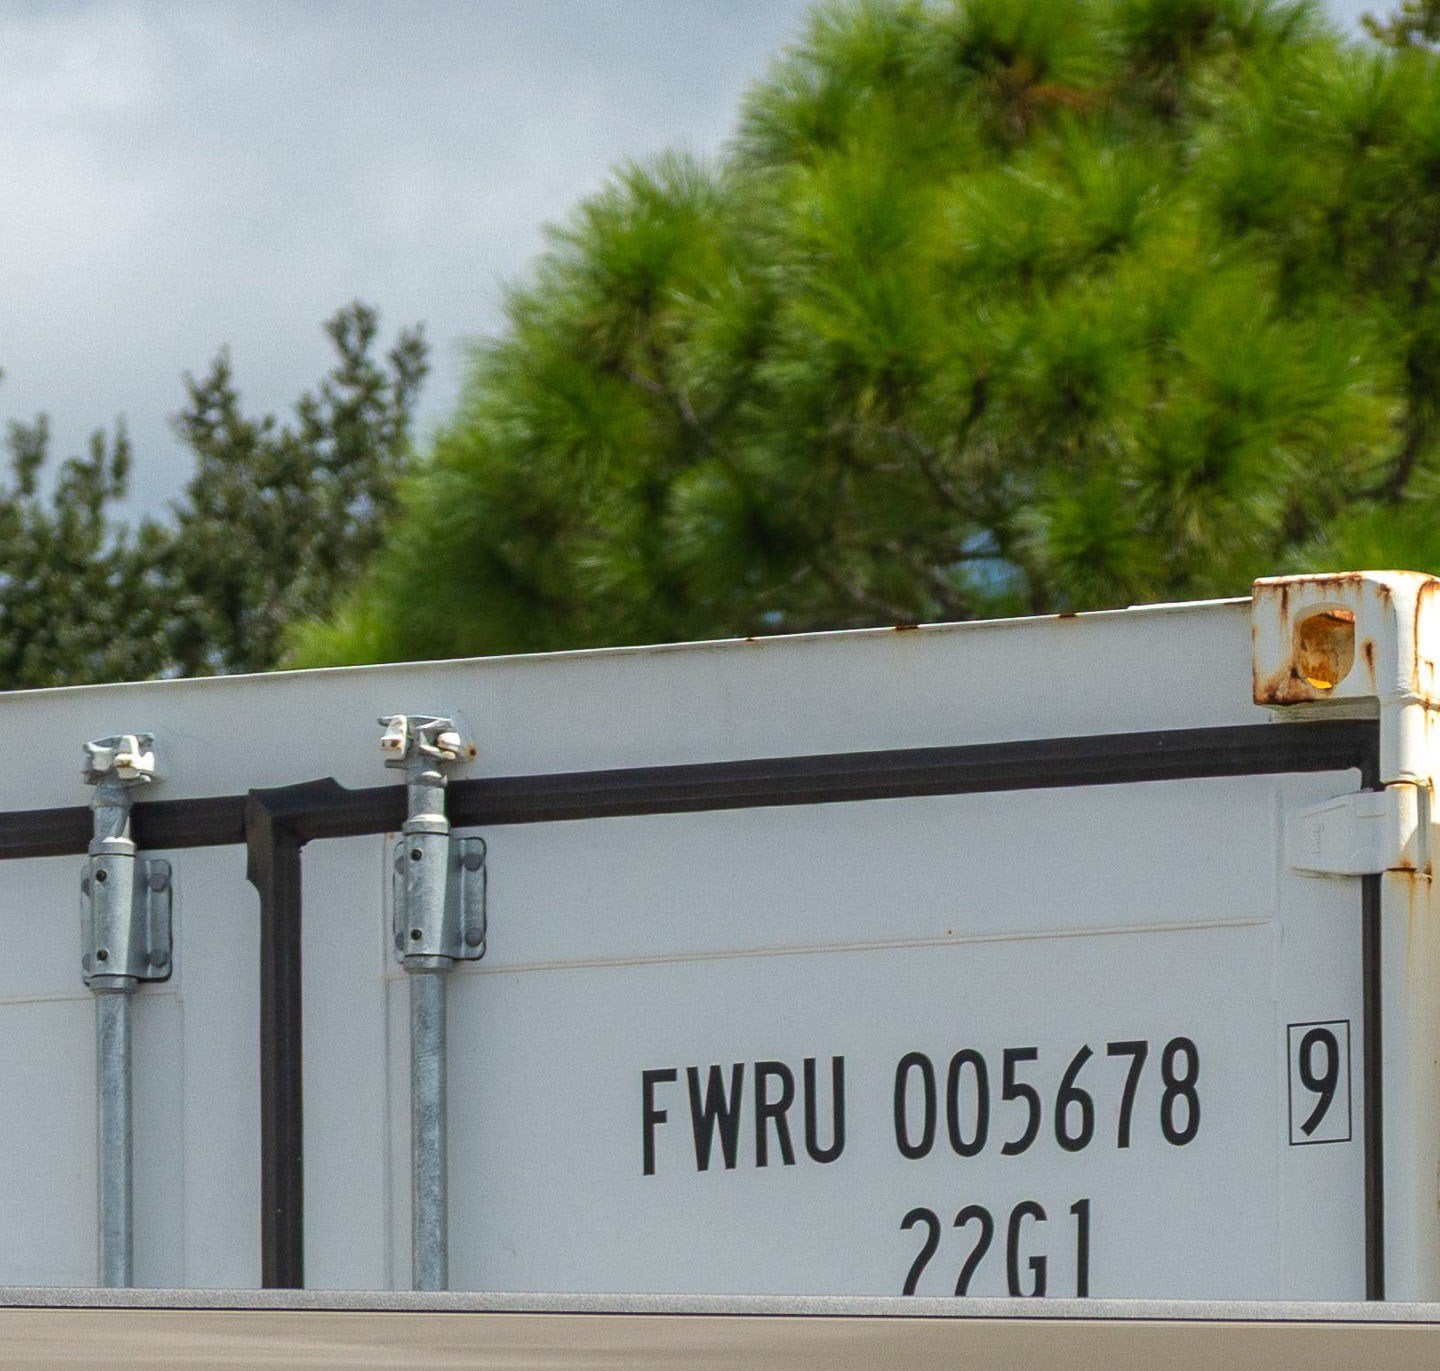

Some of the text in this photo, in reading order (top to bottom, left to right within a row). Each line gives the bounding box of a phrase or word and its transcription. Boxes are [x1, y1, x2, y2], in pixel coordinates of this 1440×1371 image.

[642, 1027, 1340, 1176] FWRU 005678 9
[900, 1198, 1090, 1297] 22G1
